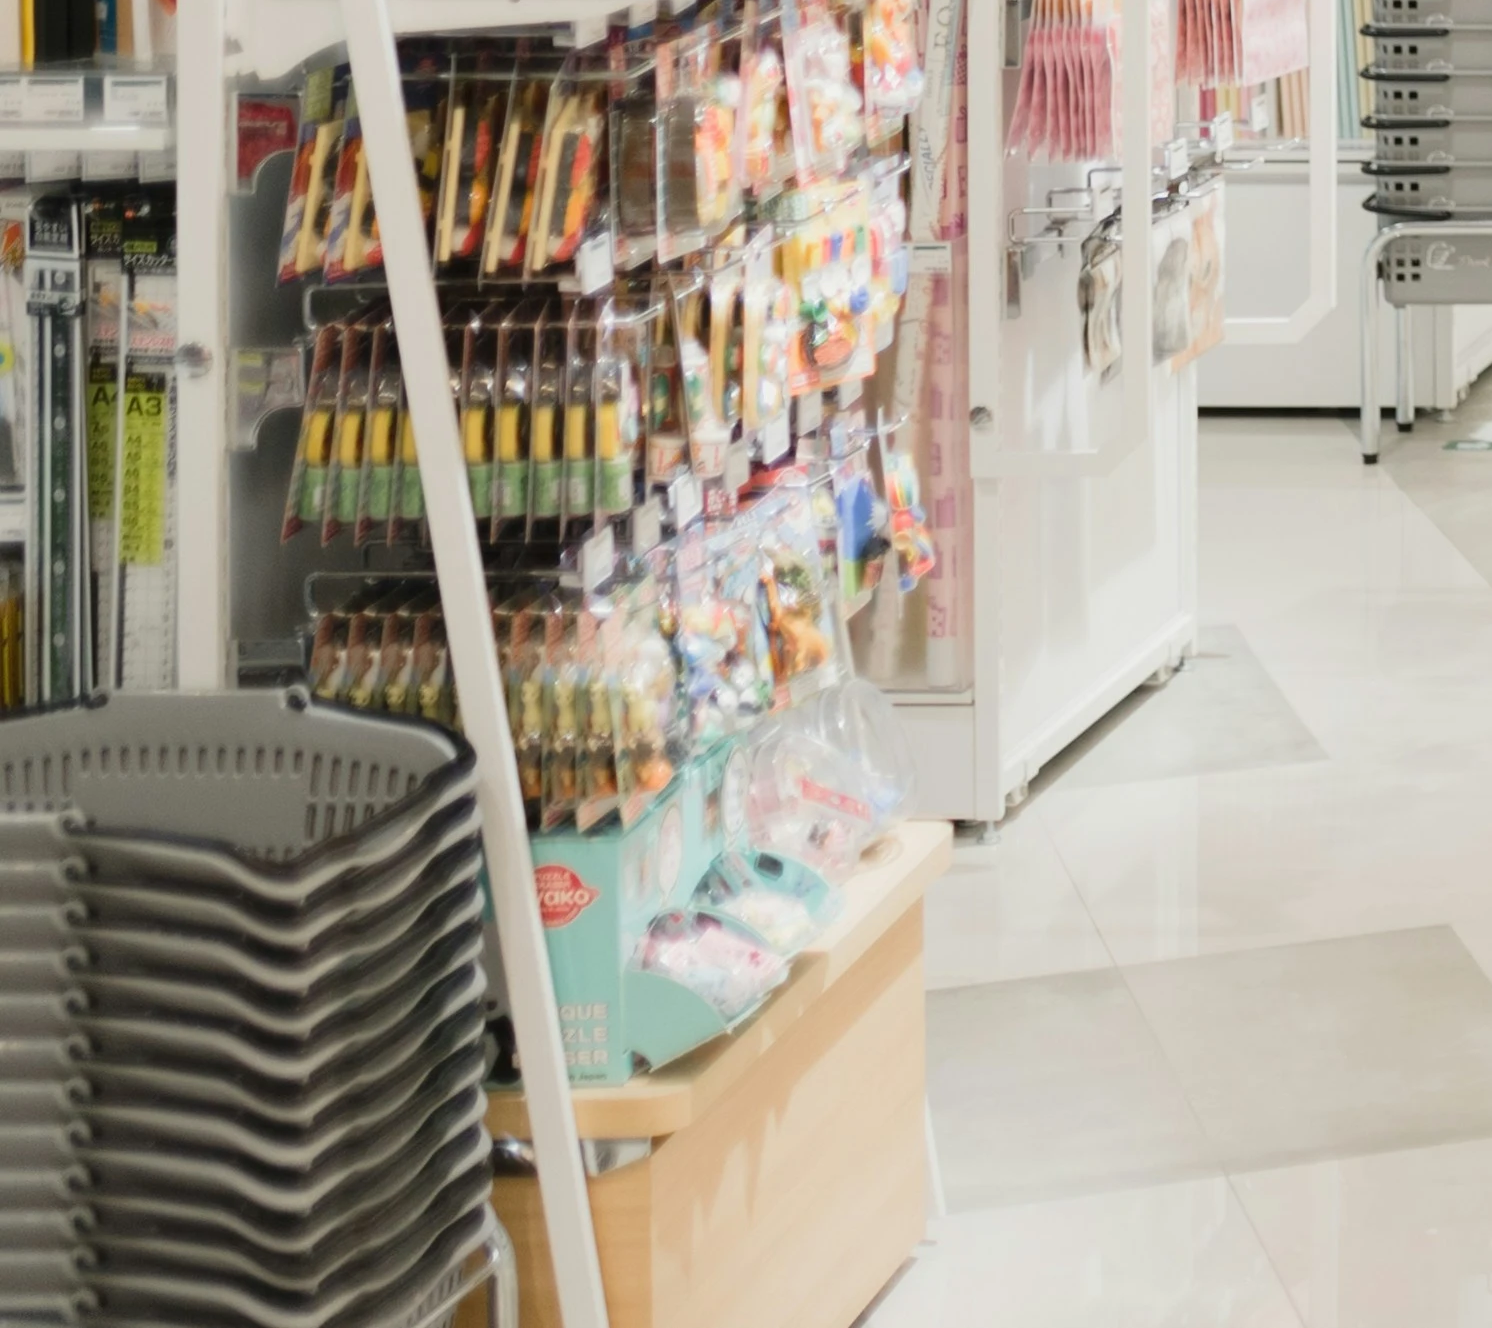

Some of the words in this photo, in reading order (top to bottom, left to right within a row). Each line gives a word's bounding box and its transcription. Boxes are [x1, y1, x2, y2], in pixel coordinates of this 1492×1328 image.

[126, 395, 162, 417] A3
[538, 889, 591, 906] ako
[559, 1004, 608, 1020] QUE
